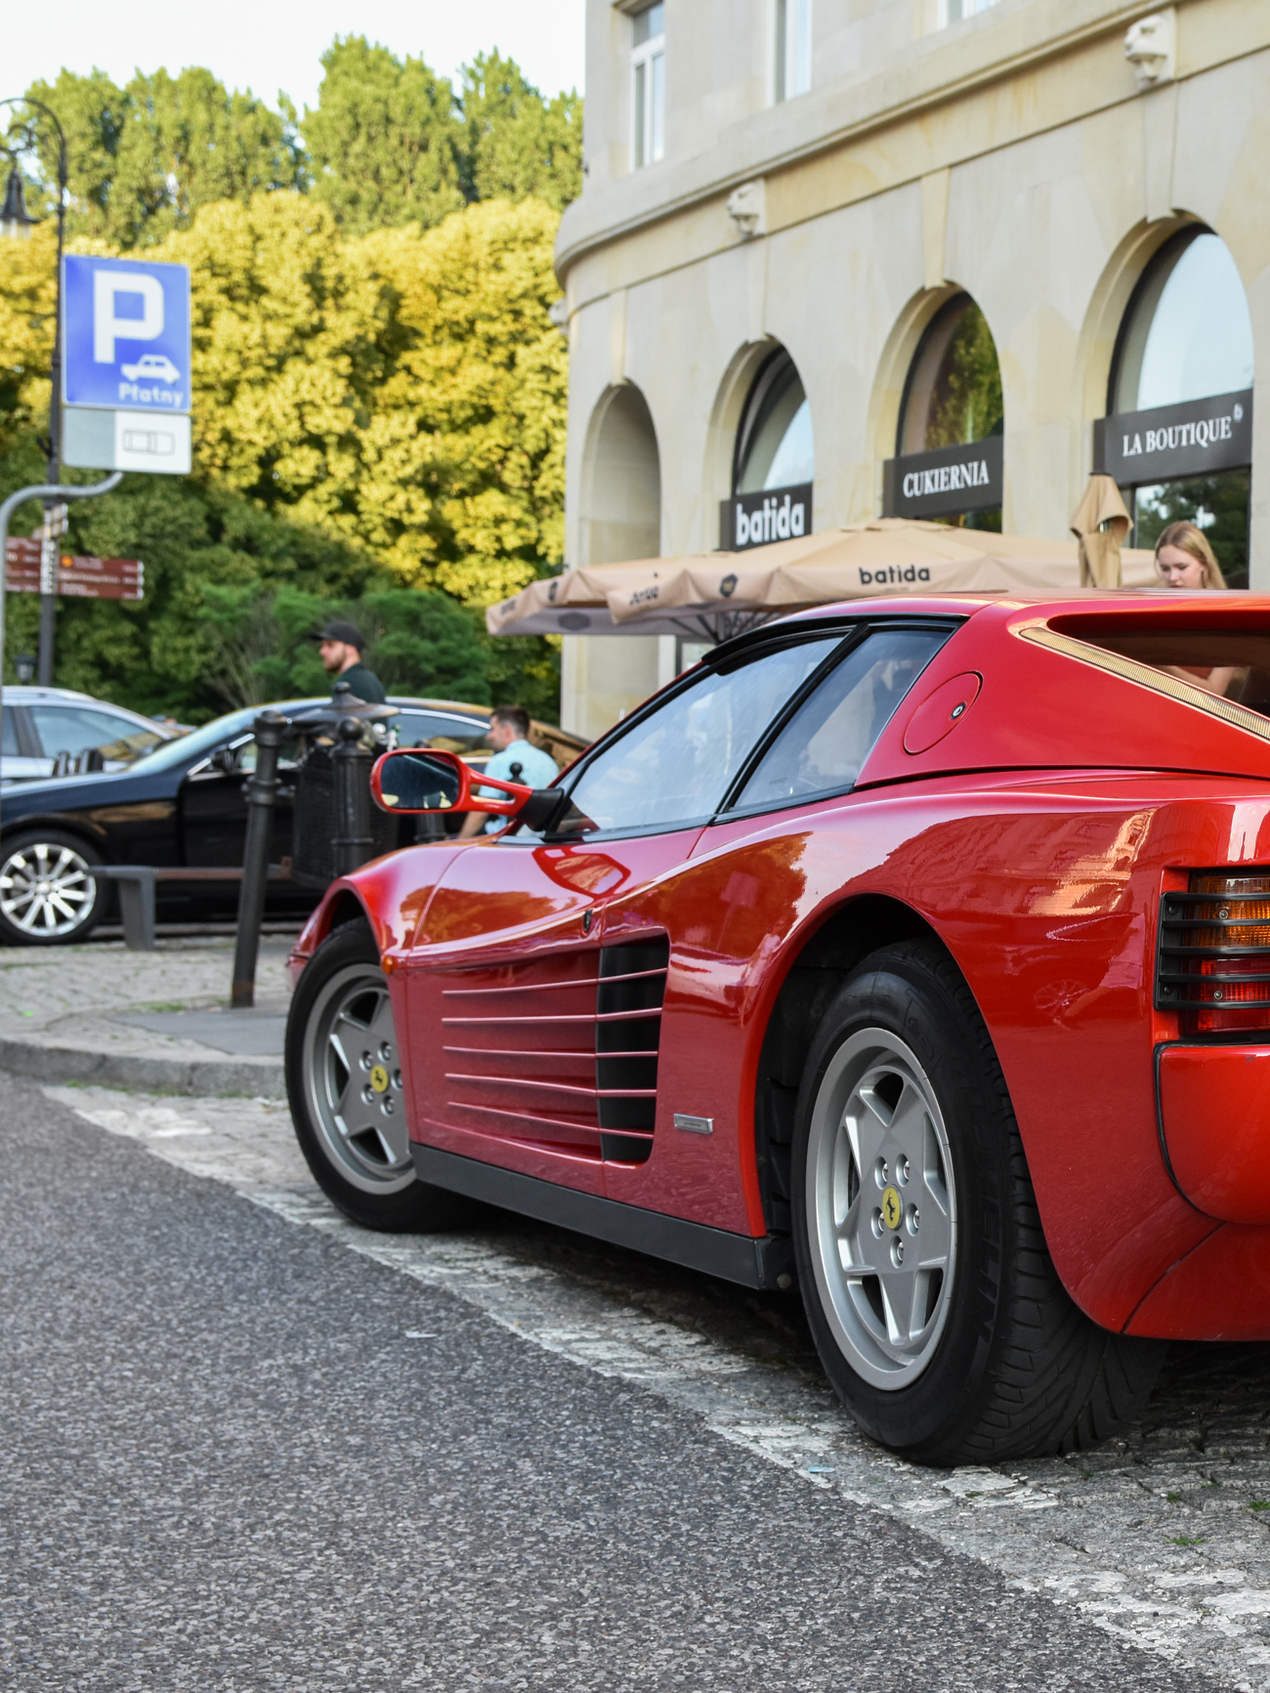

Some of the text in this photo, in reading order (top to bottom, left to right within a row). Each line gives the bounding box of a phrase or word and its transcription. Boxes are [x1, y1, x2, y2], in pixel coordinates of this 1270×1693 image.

[93, 269, 164, 364] P
[1122, 432, 1142, 457] LA
[1145, 415, 1232, 453] BOUTIQUE
[903, 459, 990, 498] CUKIERNIA
[736, 494, 805, 546] batida
[859, 564, 931, 585] batida
